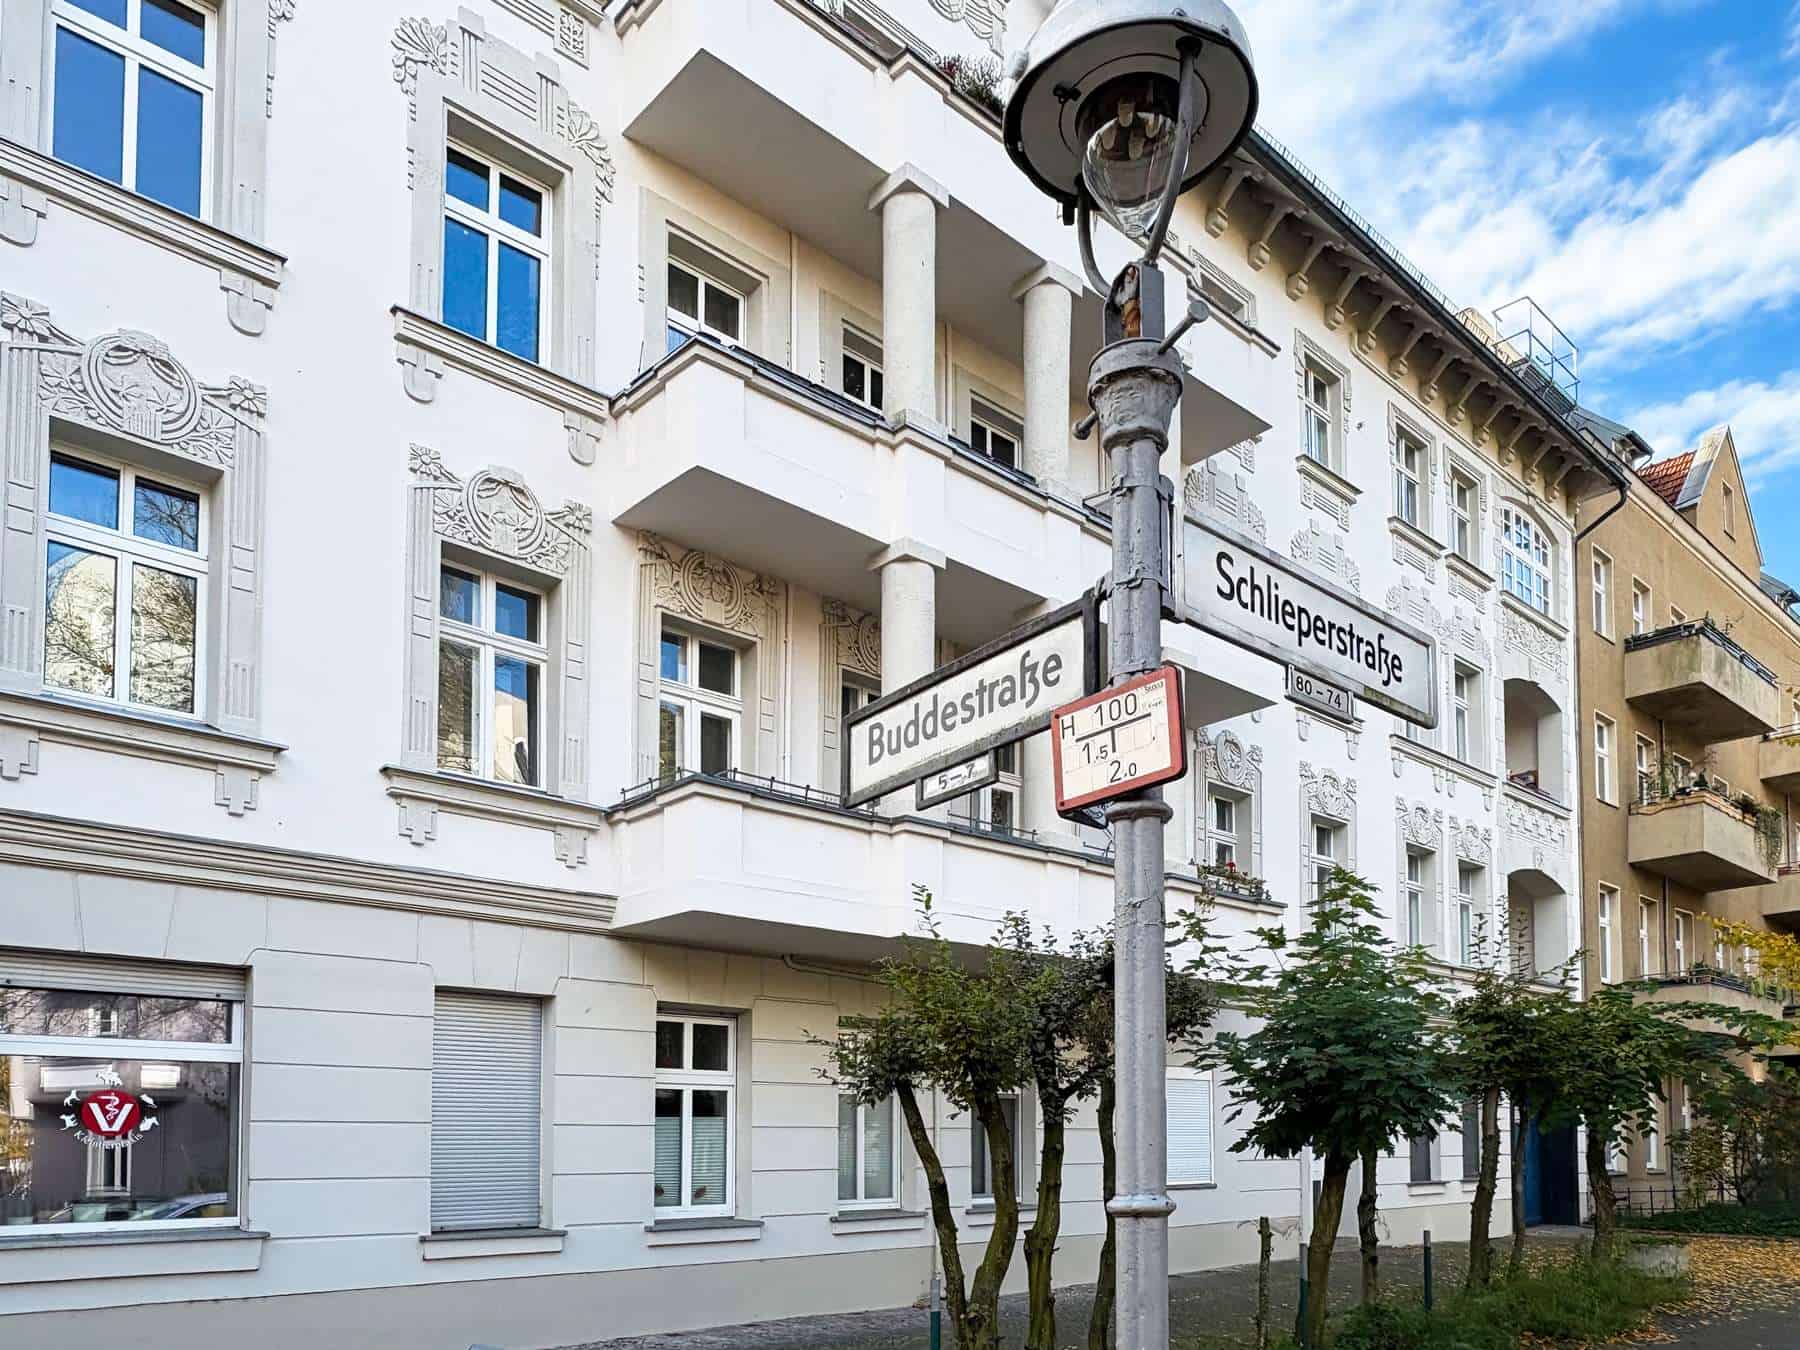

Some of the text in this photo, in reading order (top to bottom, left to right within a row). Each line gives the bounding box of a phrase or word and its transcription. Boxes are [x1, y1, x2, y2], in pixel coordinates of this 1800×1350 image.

[1216, 551, 1403, 686] Schlieperstraße
[868, 650, 1063, 766] Buddestraße
[1061, 715, 1075, 740] H
[1094, 692, 1137, 727] 100
